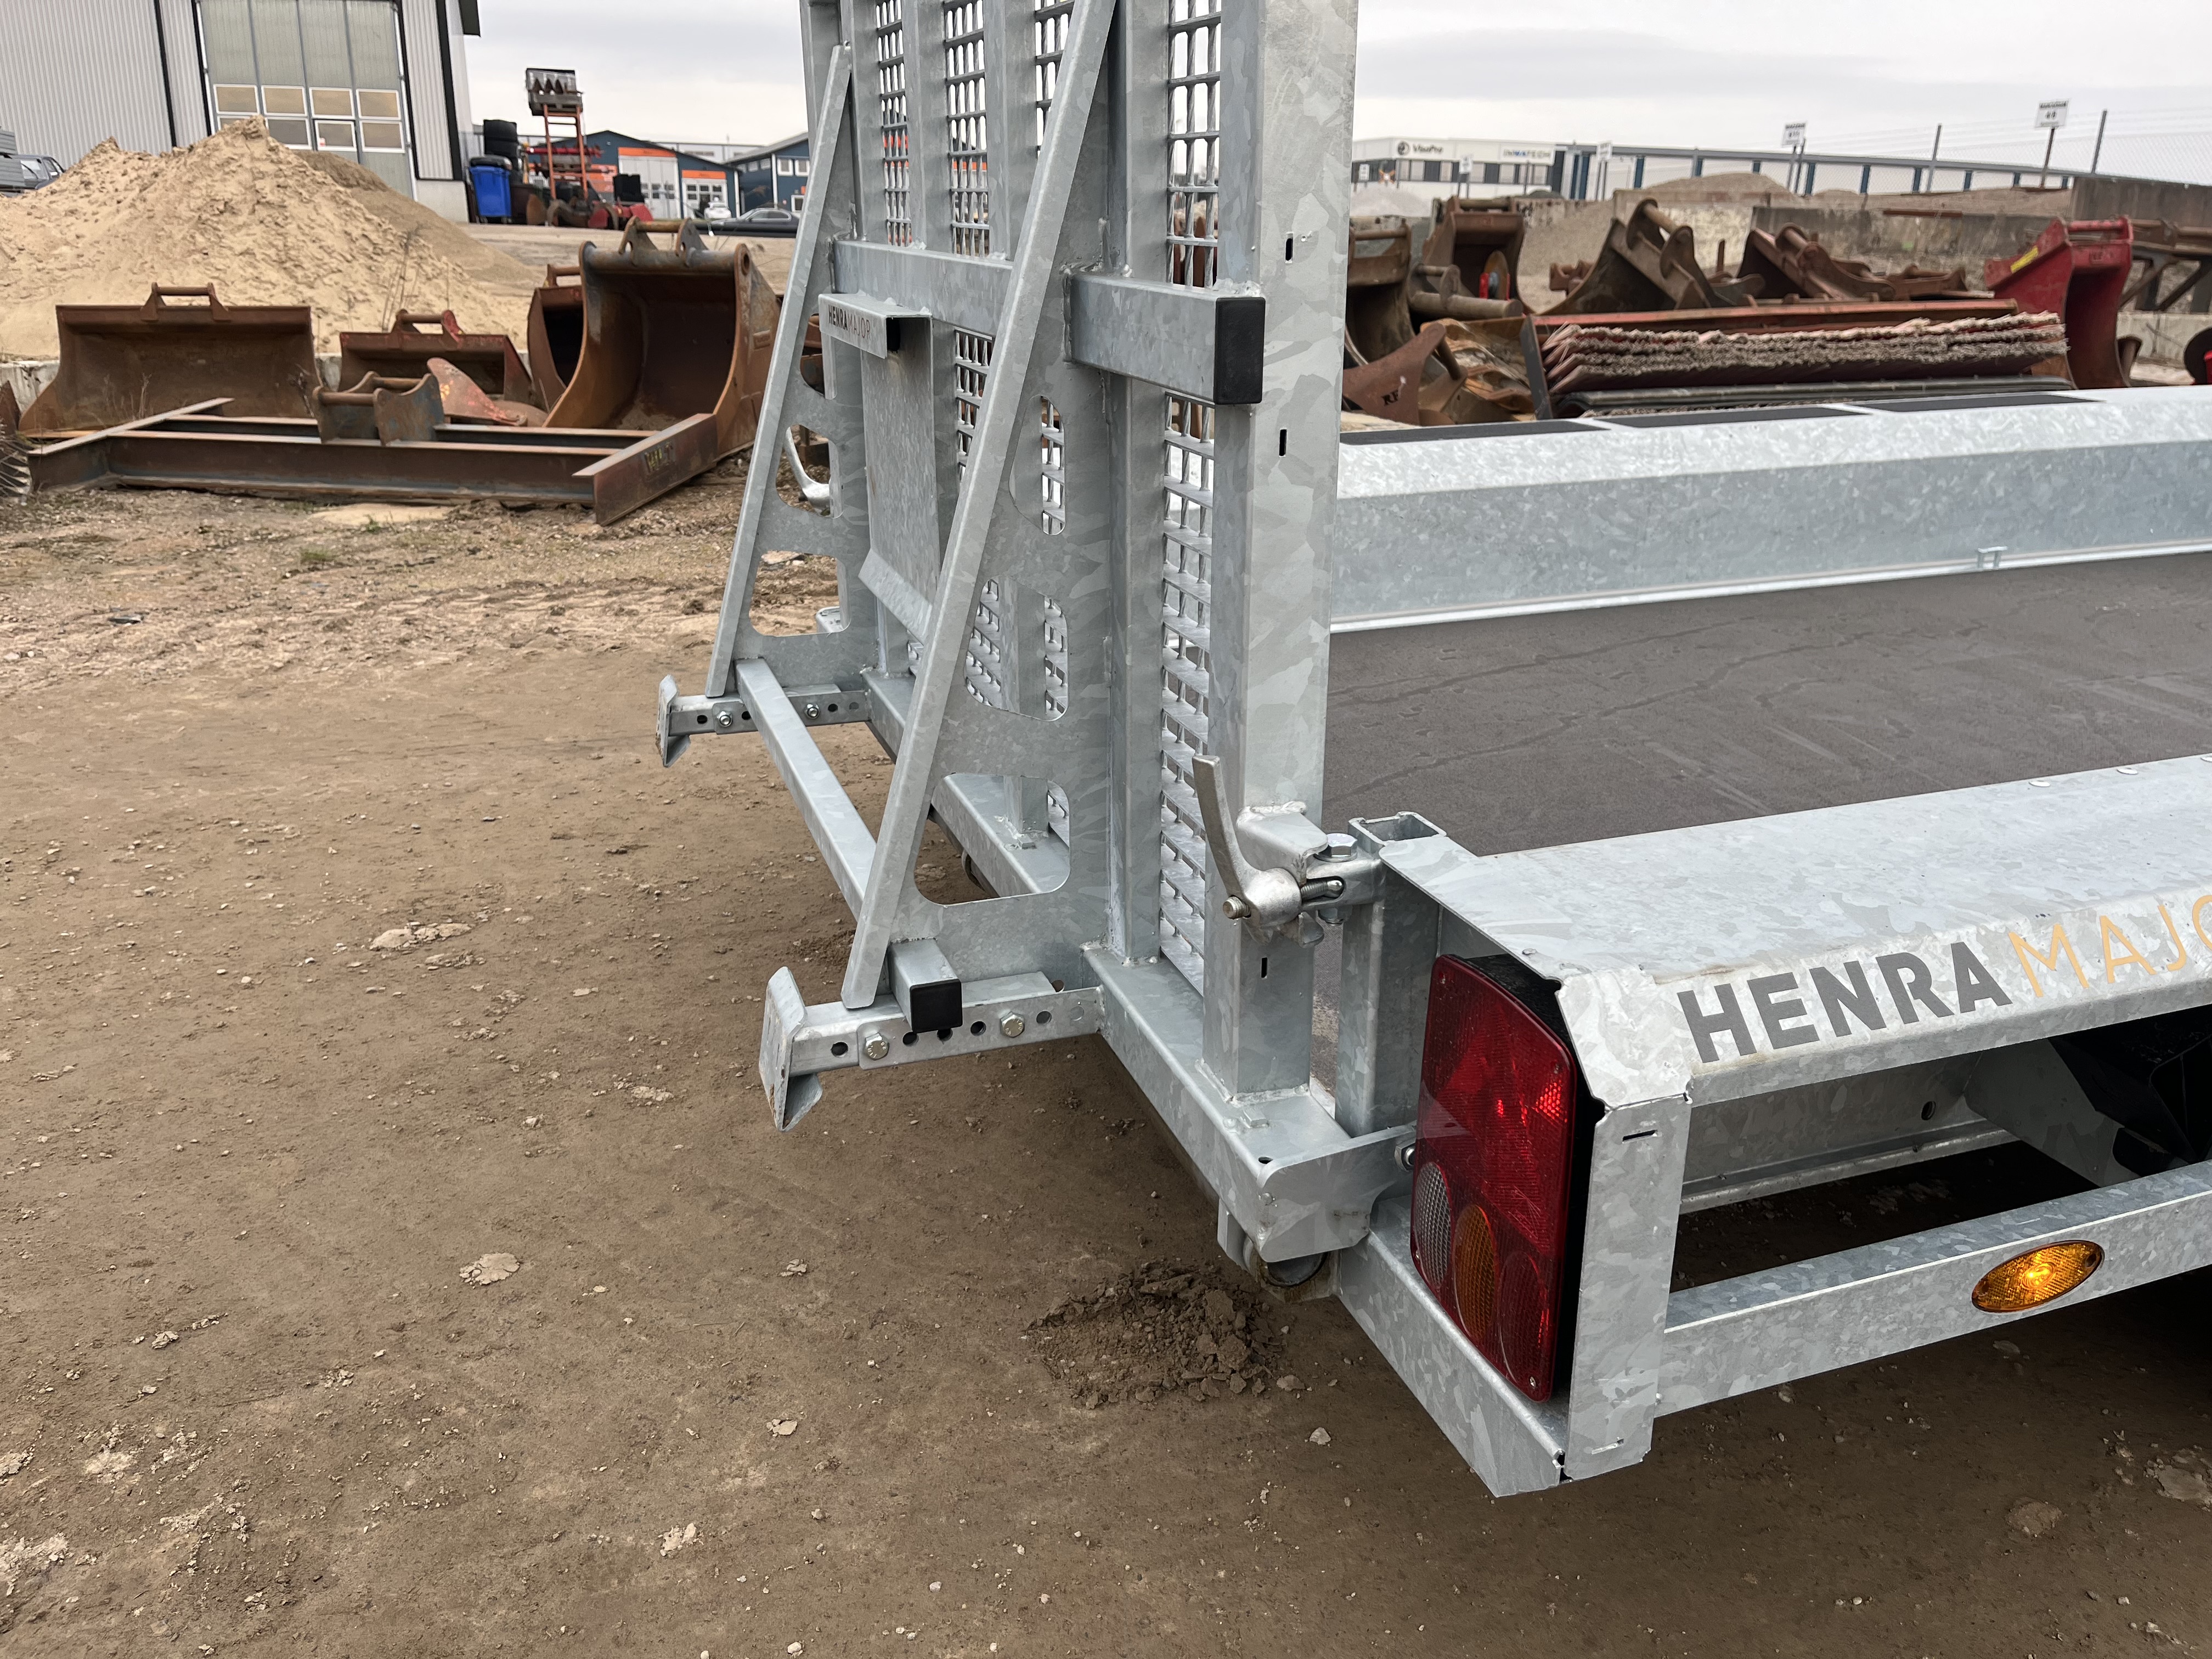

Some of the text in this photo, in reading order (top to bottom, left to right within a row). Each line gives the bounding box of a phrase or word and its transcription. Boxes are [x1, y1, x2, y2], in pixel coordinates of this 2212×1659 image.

[828, 304, 871, 340] HENRA MAJOR
[1677, 941, 2013, 1063] HENRA
